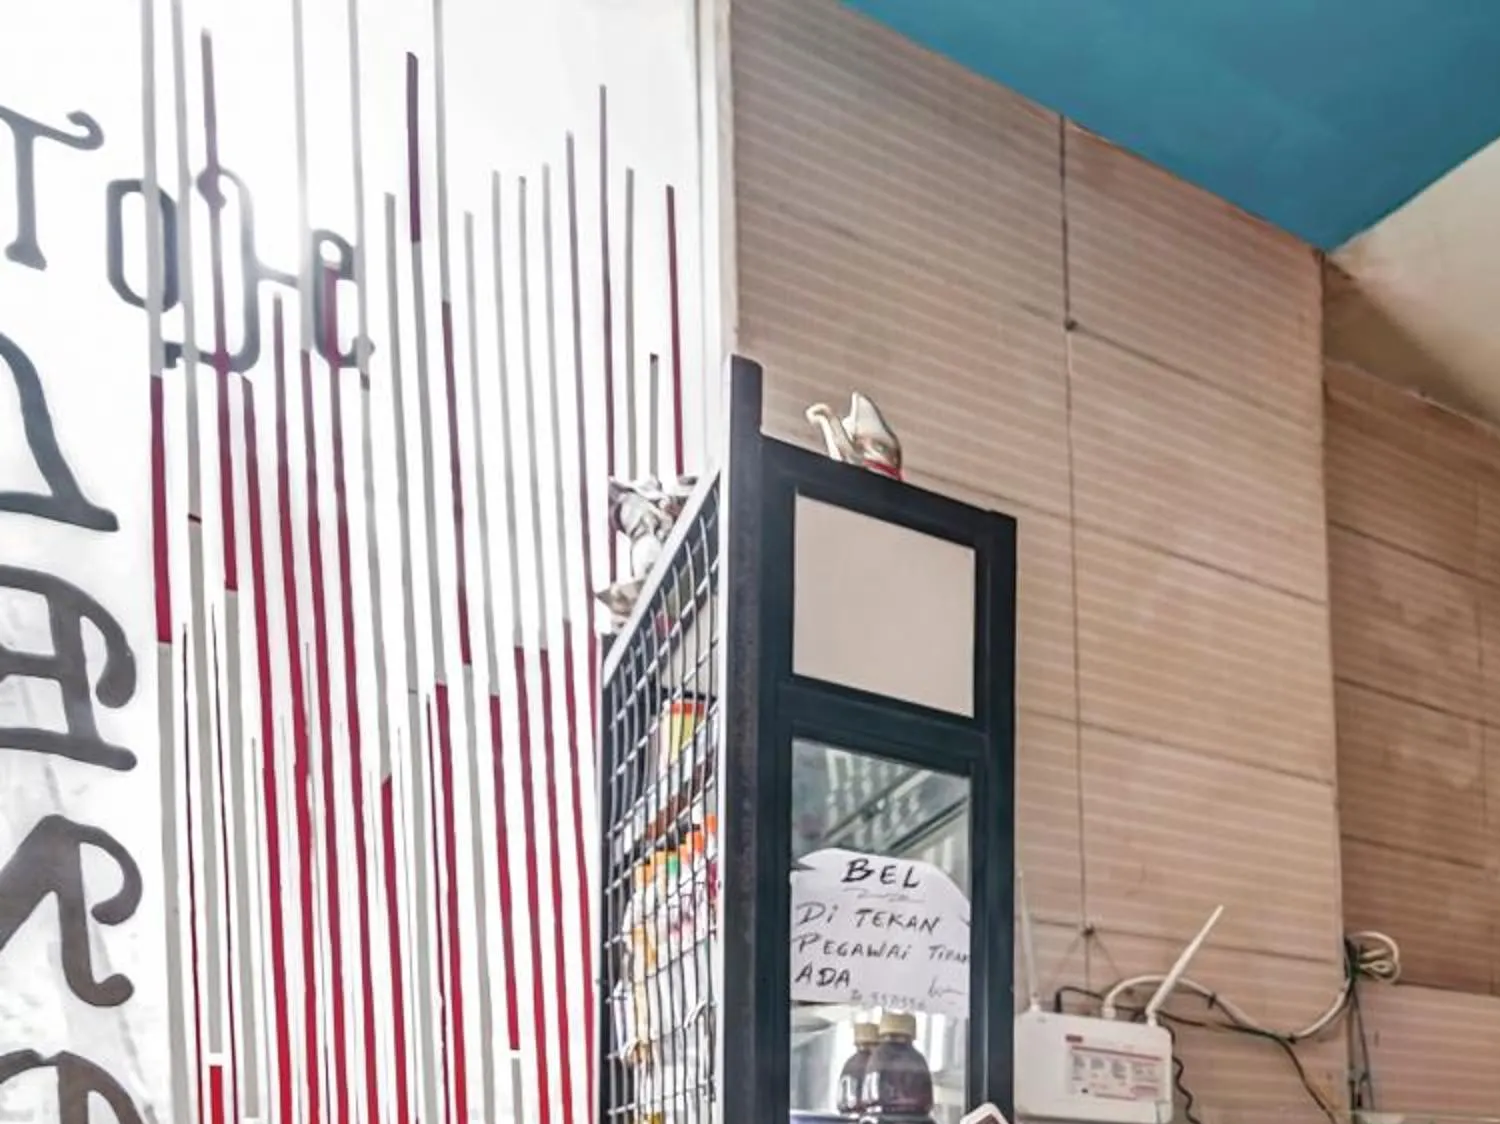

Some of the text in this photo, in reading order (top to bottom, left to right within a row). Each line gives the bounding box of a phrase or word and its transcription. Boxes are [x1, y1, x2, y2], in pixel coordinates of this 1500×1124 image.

[841, 857, 921, 889] BEL
[855, 908, 941, 936] TEKAN
[794, 962, 851, 989] ADA
